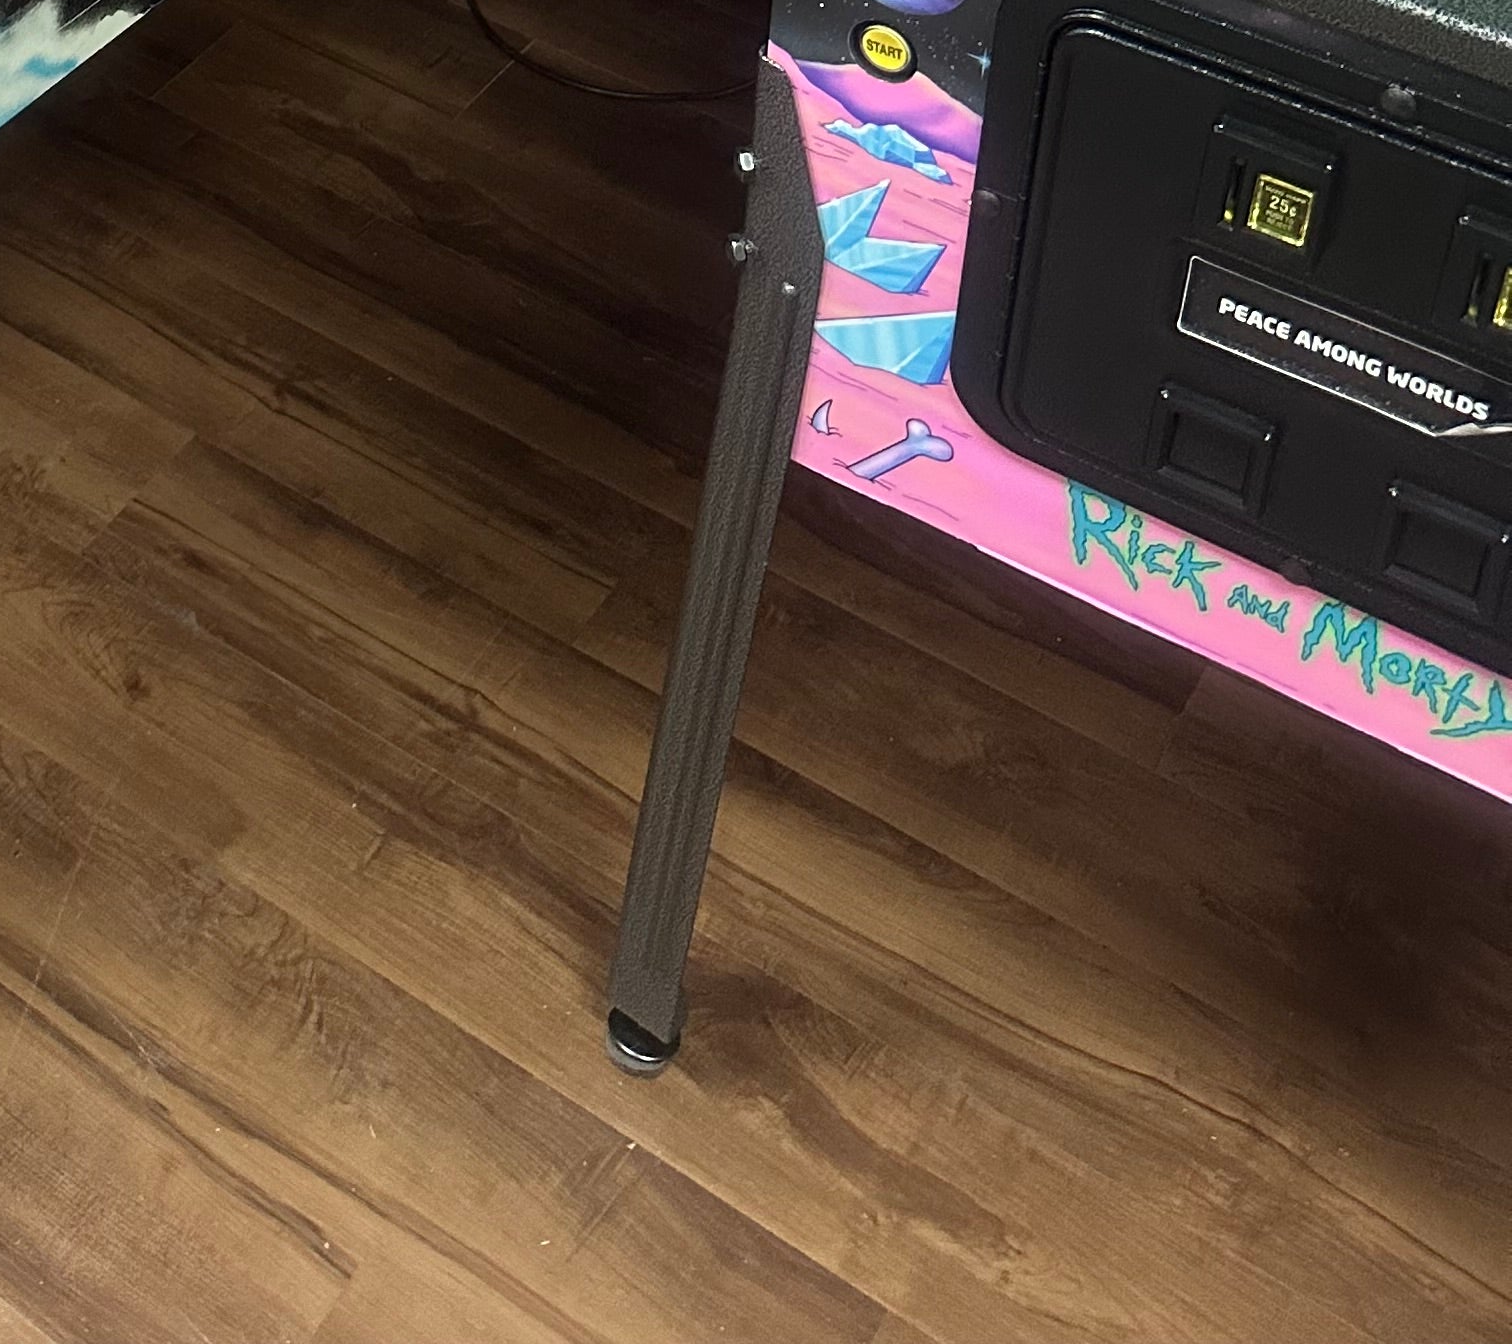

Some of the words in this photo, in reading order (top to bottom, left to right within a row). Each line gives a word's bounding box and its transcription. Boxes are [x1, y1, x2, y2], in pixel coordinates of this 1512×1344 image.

[866, 38, 904, 61] START
[1268, 194, 1298, 218] 25¢
[1217, 296, 1293, 341] PEACE
[1293, 328, 1384, 379] AMONG
[1386, 365, 1491, 422] WORLDS
[1066, 475, 1223, 613] Rick
